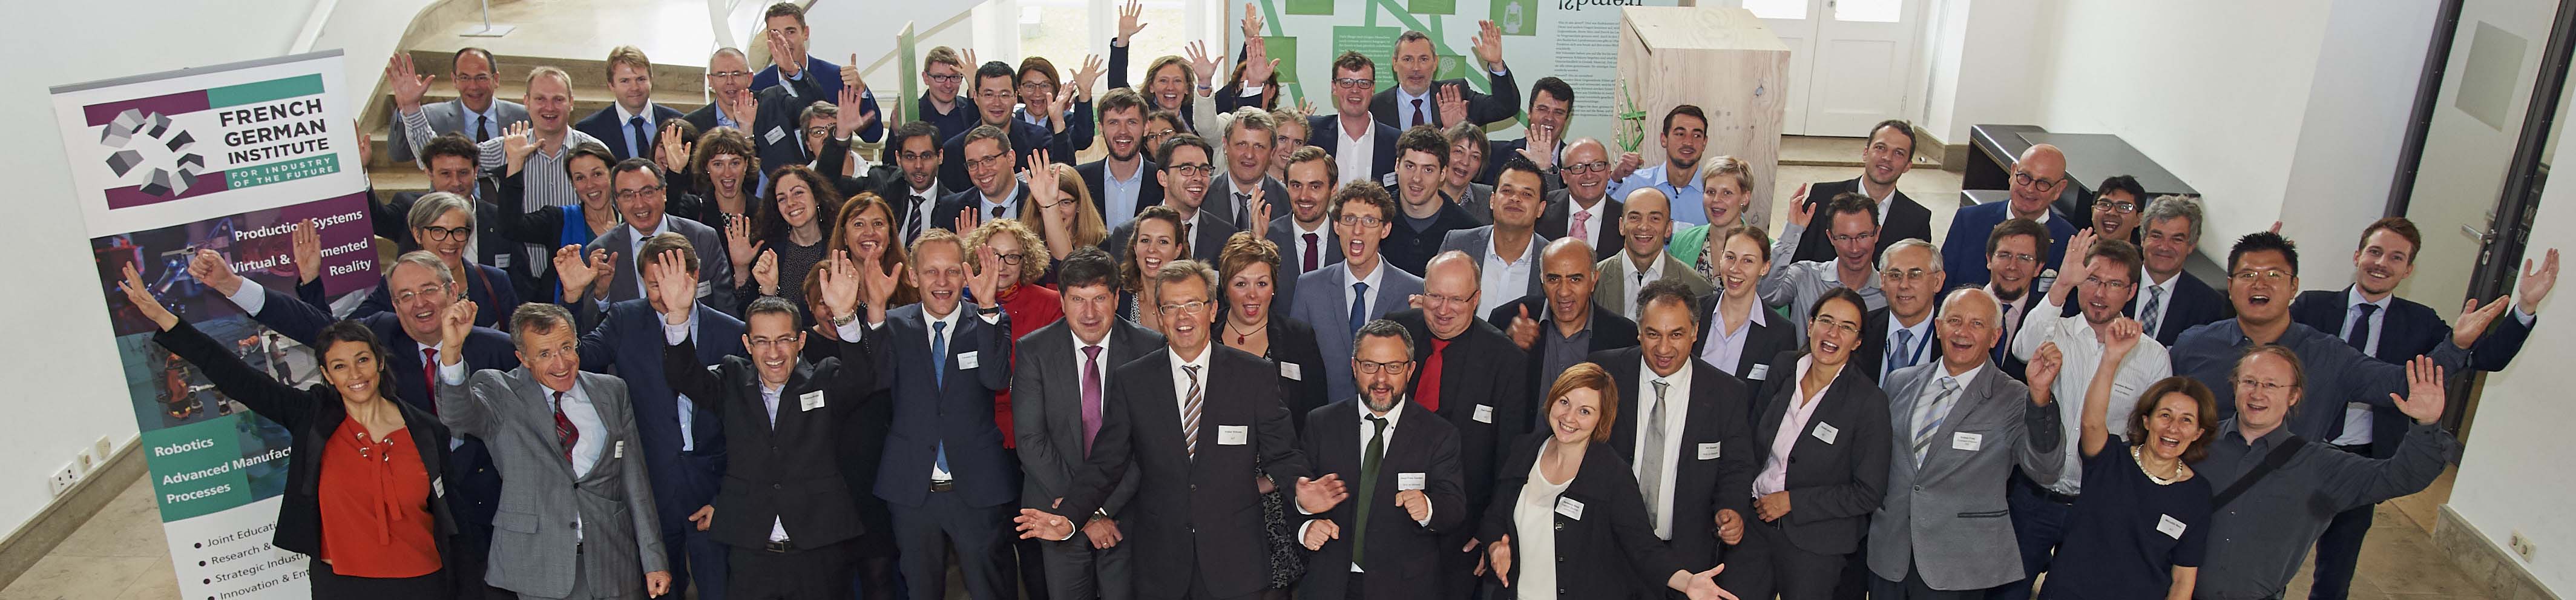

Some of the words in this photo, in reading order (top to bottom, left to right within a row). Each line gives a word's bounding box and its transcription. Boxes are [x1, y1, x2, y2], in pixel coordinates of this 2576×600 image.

[219, 98, 323, 127] FRENCH
[225, 119, 326, 147] GERMAN
[228, 137, 329, 165] INSTITUTE
[232, 170, 258, 179] FOR
[266, 157, 330, 174] INDUSTRY
[234, 179, 250, 188] OF
[257, 175, 281, 185] THE
[287, 166, 334, 180] FUTURE
[235, 222, 298, 242] Productio
[311, 210, 363, 230] Systems
[230, 255, 276, 274] Virtual
[280, 254, 291, 265] &
[329, 259, 372, 276] Reality
[154, 438, 214, 457] Robotics
[162, 462, 229, 486] Advanced
[166, 483, 231, 504] Processes
[208, 533, 234, 547] Joint
[211, 546, 260, 564] Research
[215, 563, 265, 582] Strategic
[220, 578, 279, 600] Innovation
[282, 574, 290, 582] &
